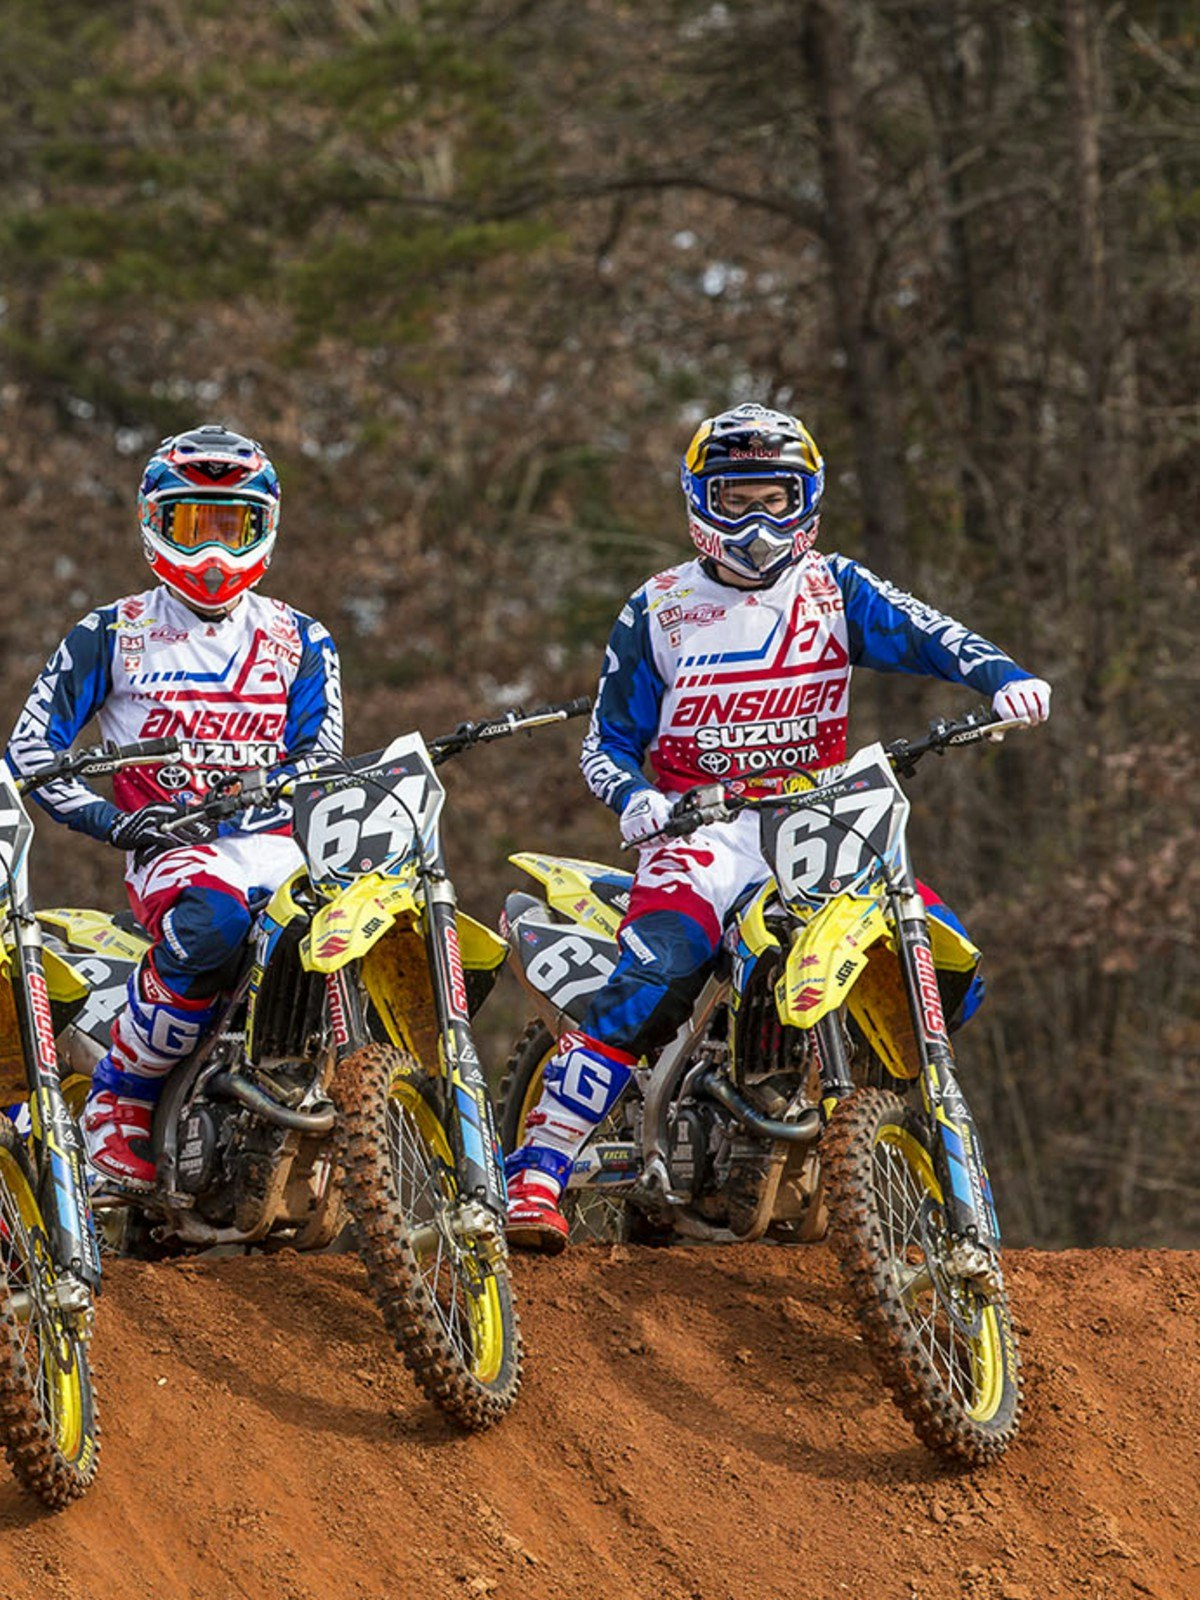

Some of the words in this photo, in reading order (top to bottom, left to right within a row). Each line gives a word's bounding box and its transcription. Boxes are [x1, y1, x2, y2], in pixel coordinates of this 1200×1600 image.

[730, 446, 755, 461] Red
[756, 446, 781, 459] Bull
[670, 676, 849, 728] ANSWER
[138, 709, 287, 742] ANSWE
[696, 717, 819, 751] SUZUKI
[179, 742, 278, 768] UZUKI
[734, 744, 820, 771] TOYOTA
[307, 774, 428, 883] 64
[776, 786, 895, 900] 67
[362, 916, 385, 939] JGR
[526, 935, 617, 1009] 67
[834, 958, 859, 988] JGR
[913, 945, 947, 1037] SHOWA
[481, 1123, 499, 1196] DUNLOP
[574, 1159, 591, 1174] GR
[968, 1158, 989, 1238] DUNLOP
[75, 1187, 94, 1269] DUNLOP
